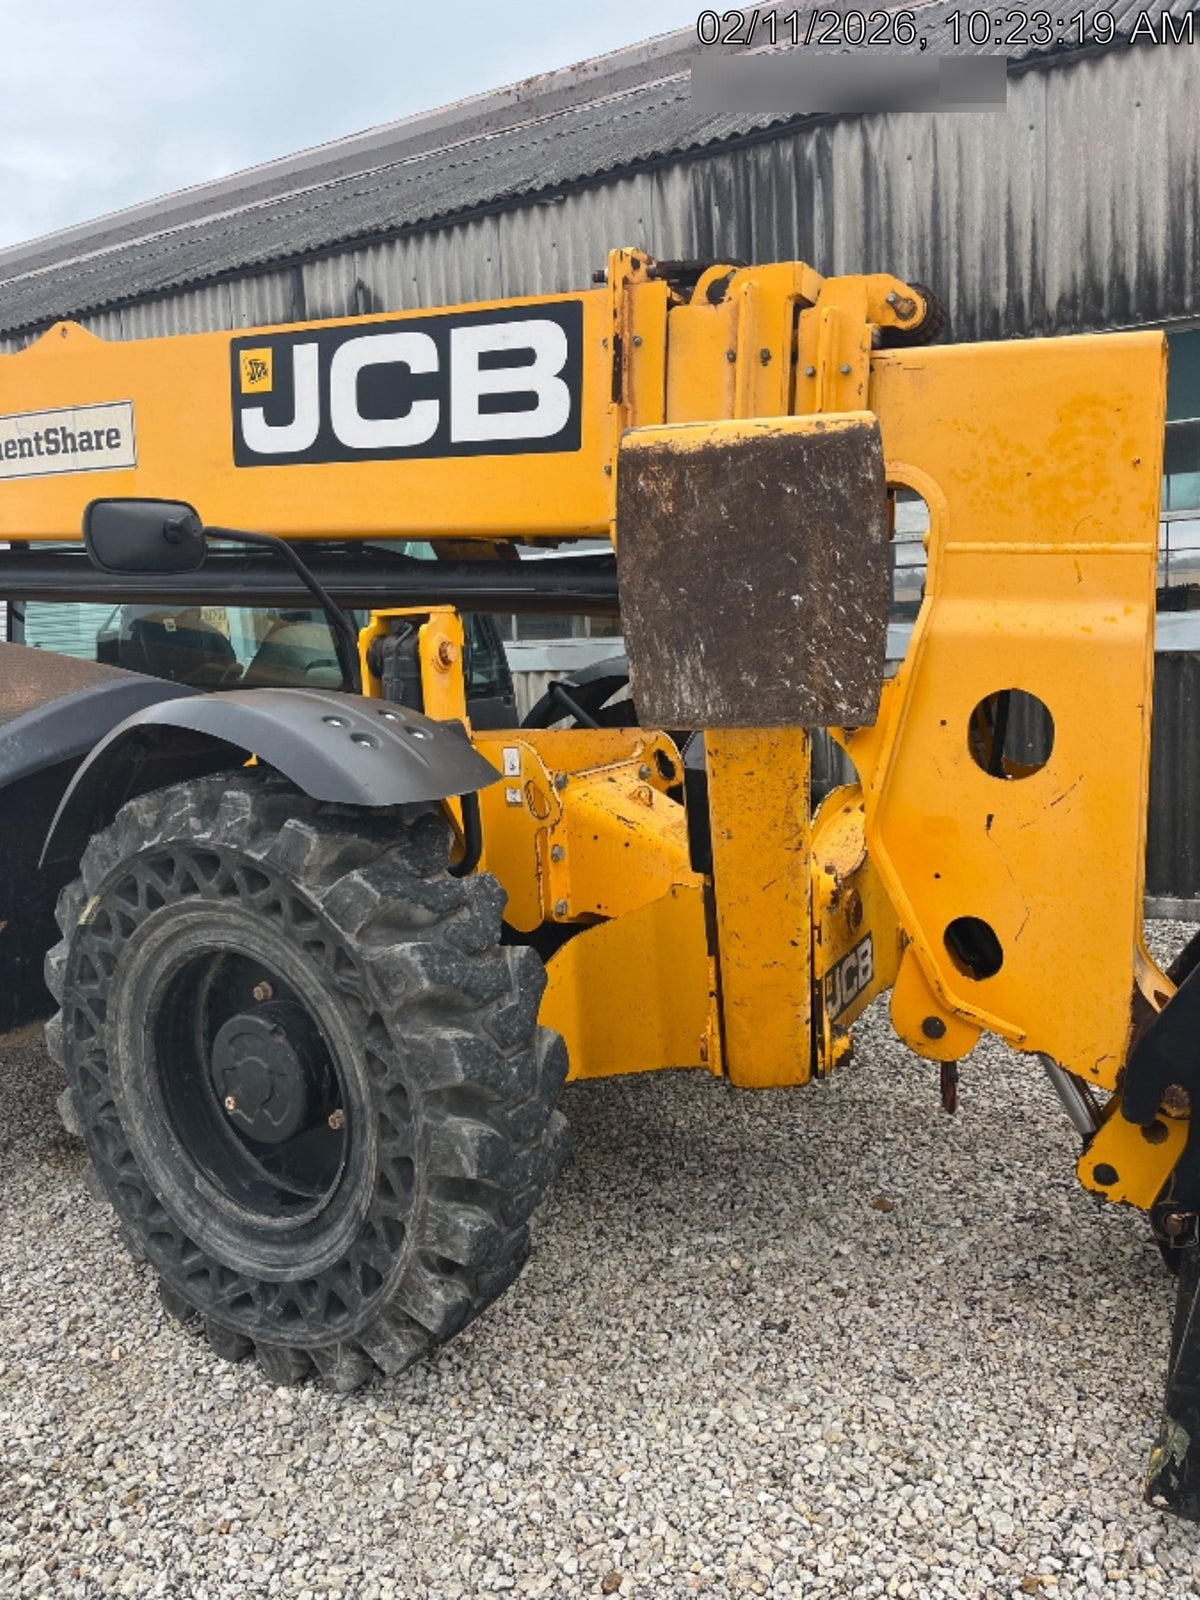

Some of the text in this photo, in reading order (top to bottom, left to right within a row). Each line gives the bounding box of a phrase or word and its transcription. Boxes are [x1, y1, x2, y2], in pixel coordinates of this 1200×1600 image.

[240, 319, 571, 454] JCB
[0, 426, 121, 460] entShare
[826, 938, 872, 1020] JCB
